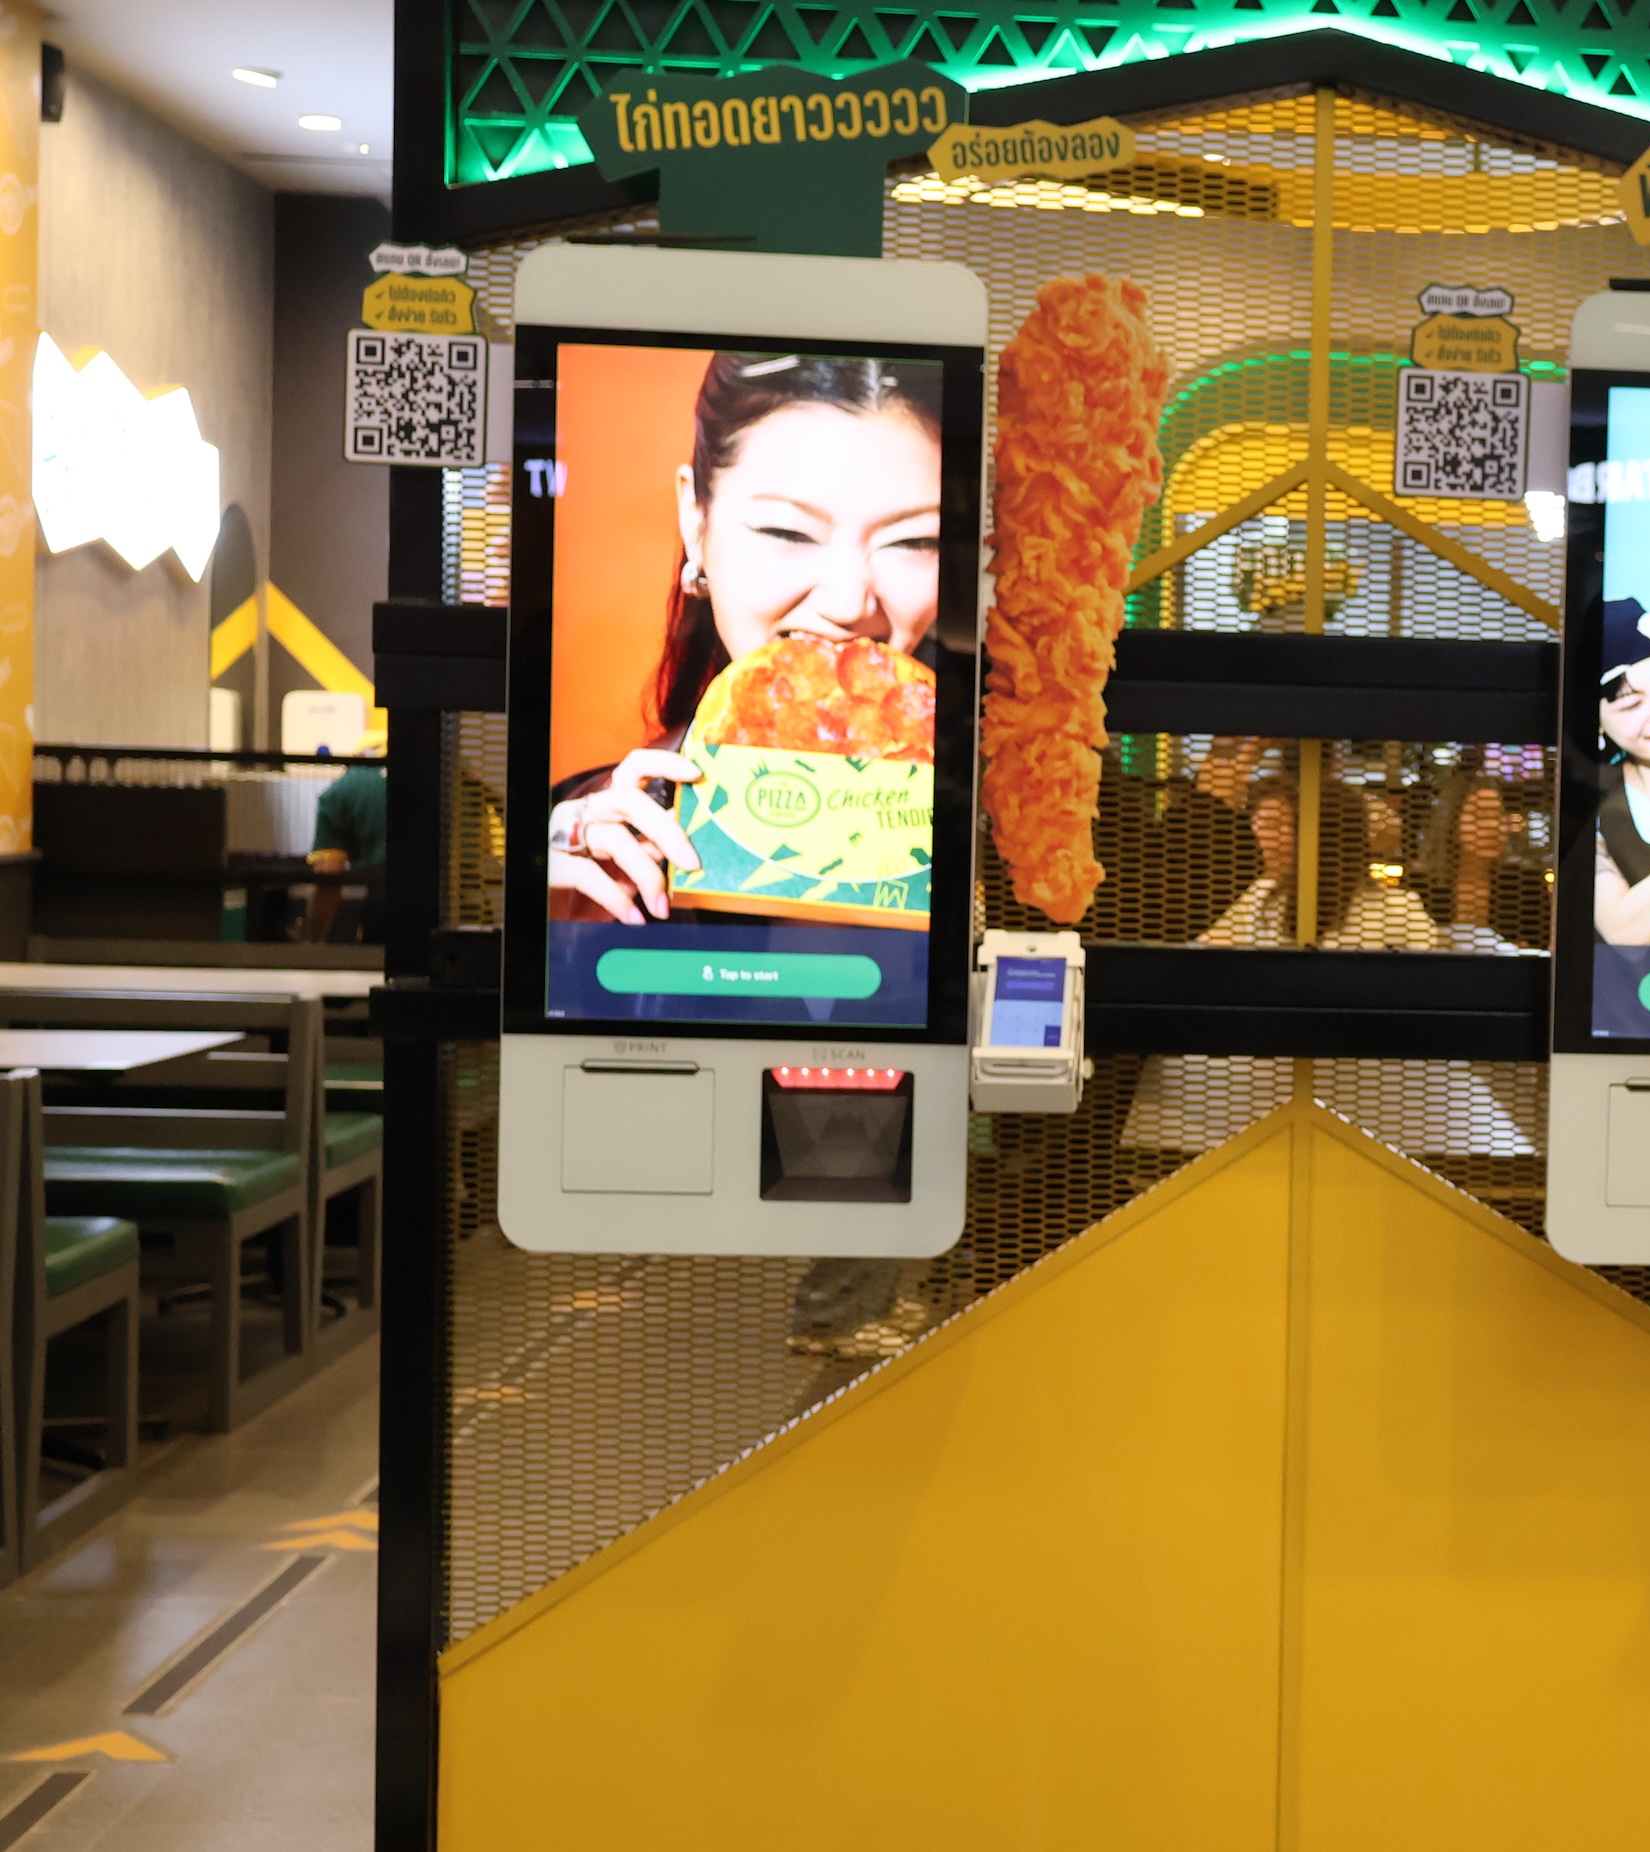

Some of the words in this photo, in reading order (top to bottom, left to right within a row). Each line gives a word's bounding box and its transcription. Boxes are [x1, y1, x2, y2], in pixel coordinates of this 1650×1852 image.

[609, 86, 948, 152] ไก่ทอดยาววววว
[951, 127, 1121, 169] อร่อยต้องลอง
[757, 787, 807, 811] PIZZA
[826, 786, 909, 811] Chicken
[719, 968, 740, 982] Tap
[740, 969, 753, 981] to
[753, 970, 779, 982] start
[628, 1042, 667, 1054] PRINT
[830, 1050, 866, 1061] SCAN
